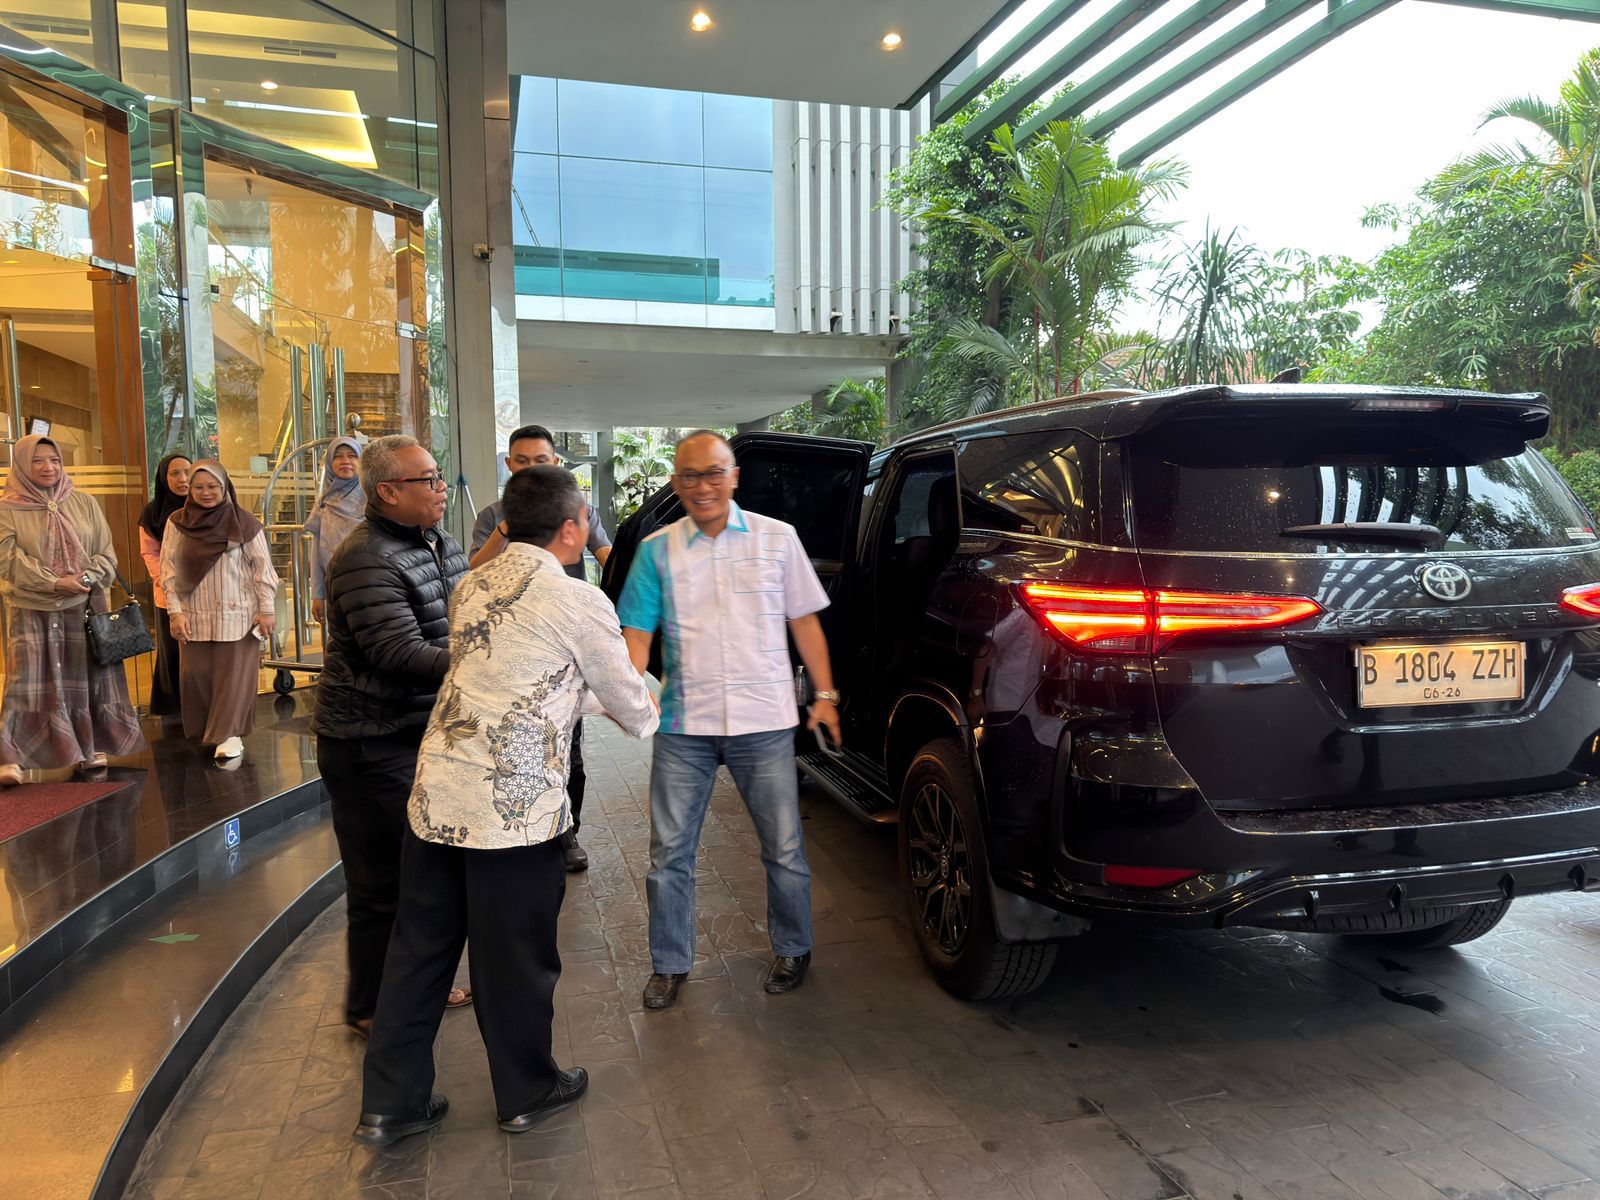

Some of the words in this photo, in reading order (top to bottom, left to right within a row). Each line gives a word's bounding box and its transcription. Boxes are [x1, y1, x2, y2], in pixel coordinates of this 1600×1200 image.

[1337, 609, 1562, 628] FORTUNER
[1363, 654, 1378, 685] B
[1394, 651, 1457, 684] 1804
[1472, 648, 1516, 680] ZZH
